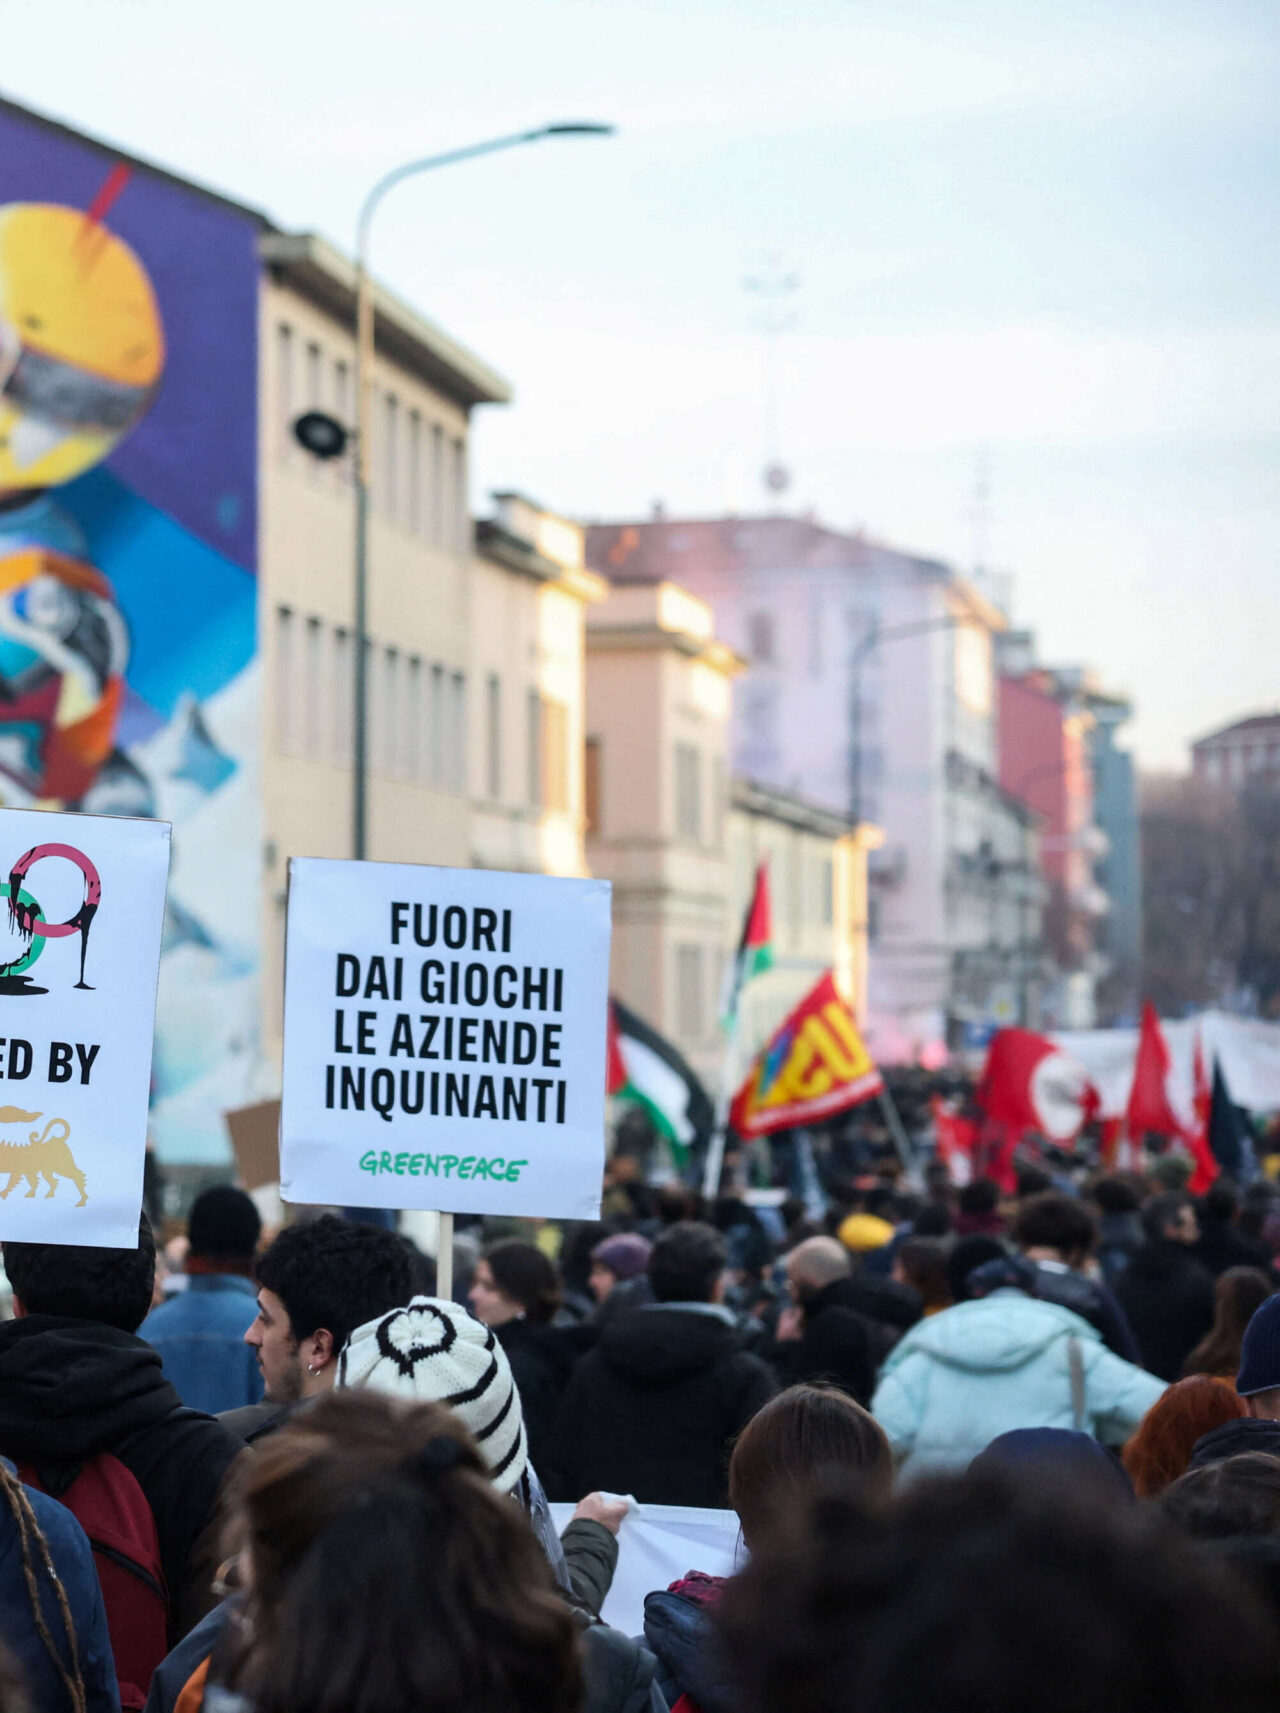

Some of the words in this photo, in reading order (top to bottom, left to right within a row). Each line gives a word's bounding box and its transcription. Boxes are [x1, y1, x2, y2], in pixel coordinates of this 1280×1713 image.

[390, 901, 513, 953] FUORI
[335, 953, 404, 1001] DAI
[420, 959, 564, 1012] GIOCHI
[47, 1041, 101, 1086] BY
[334, 1009, 377, 1056] LE
[389, 1013, 563, 1068] AZIENDE
[325, 1064, 567, 1124] INQUINANTI
[359, 1150, 529, 1183] GREENPEACE
